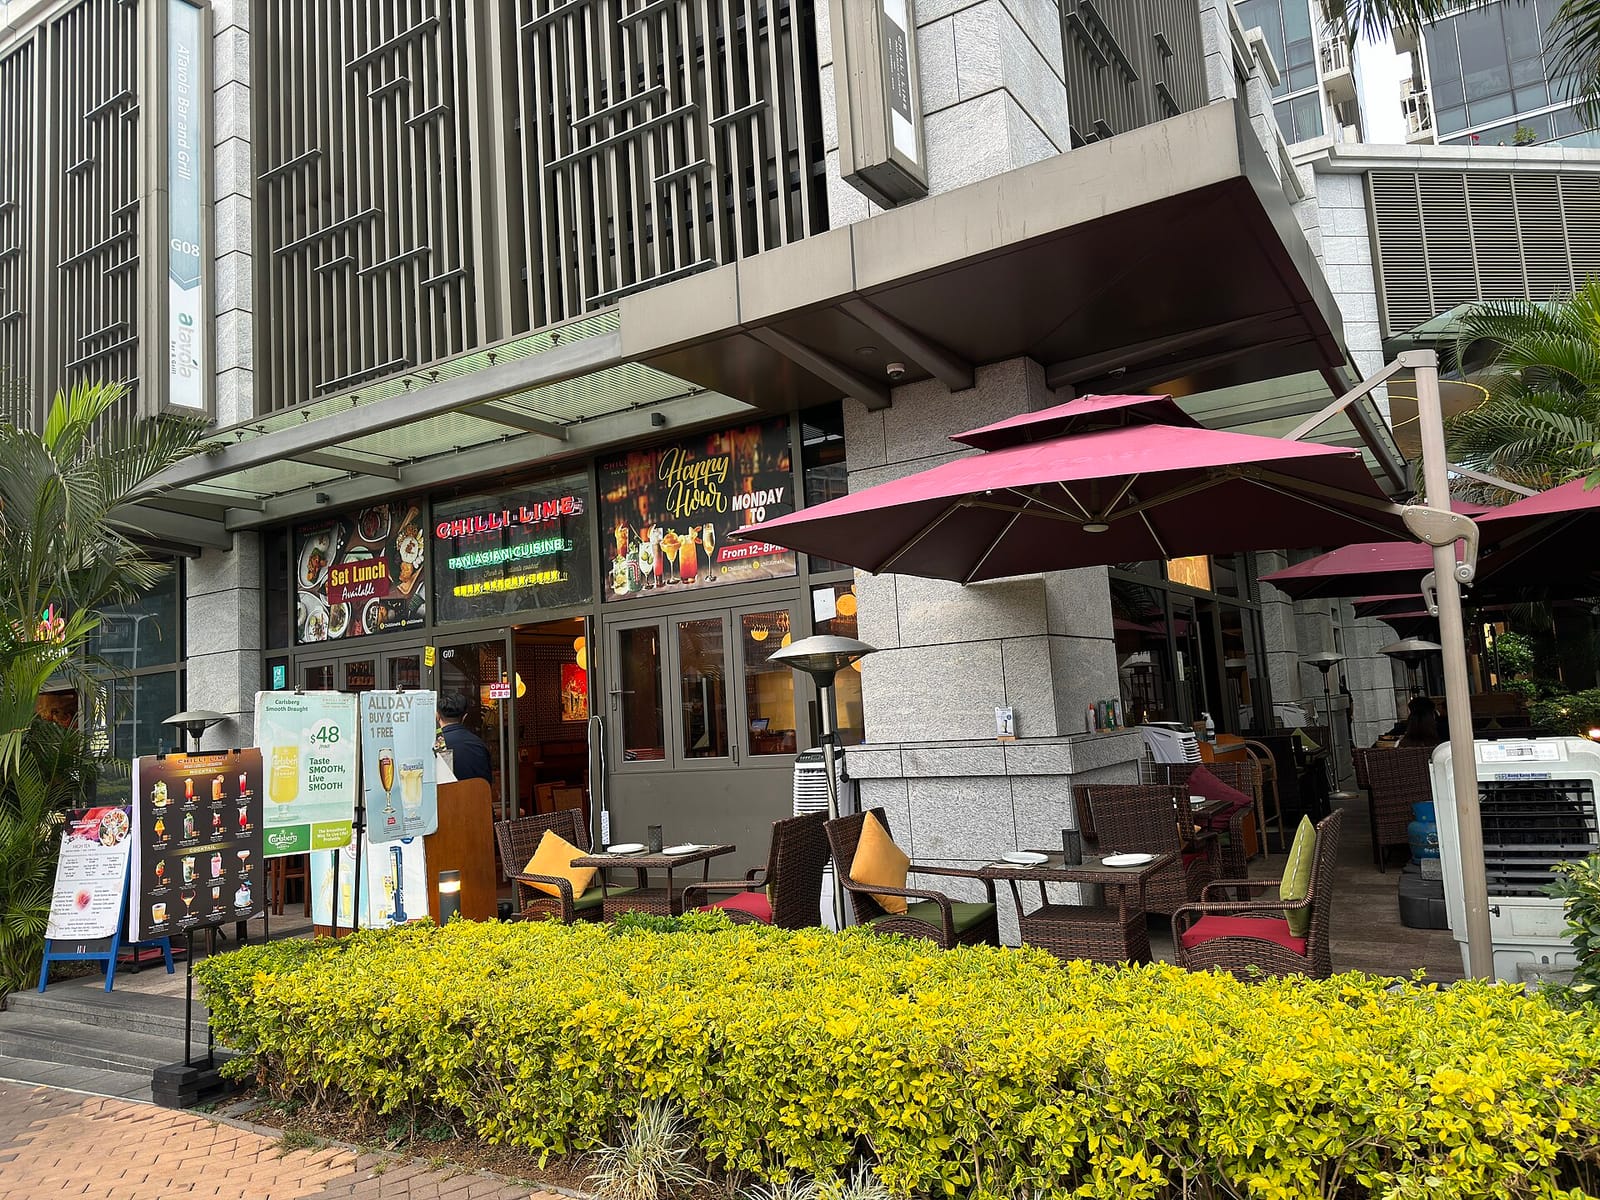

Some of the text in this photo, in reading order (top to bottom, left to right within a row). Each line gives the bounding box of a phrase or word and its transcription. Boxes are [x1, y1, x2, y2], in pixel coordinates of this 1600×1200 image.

[177, 97, 190, 123] Bar
[177, 123, 190, 149] and
[177, 150, 191, 180] Grill
[171, 238, 200, 257] G08
[658, 447, 729, 488] Happy
[666, 480, 727, 518] Hour
[731, 487, 784, 512] MONDAY
[436, 496, 575, 539] CHILLI LIME
[750, 507, 766, 524] TO
[448, 538, 565, 569] PAN ASIAN CUISINE
[722, 546, 748, 560] From
[331, 561, 386, 587] Set Lunch
[342, 582, 375, 600] Available
[442, 649, 455, 658] G07
[369, 711, 410, 723] BUY 2 GET
[310, 726, 340, 744] $48
[370, 726, 394, 738] 1 FREE
[308, 765, 346, 774] SMOOTH,
[309, 757, 330, 765] Taste
[308, 774, 325, 783] Live
[308, 782, 343, 791] SMOOTH
[268, 832, 297, 846] Carlsberg
